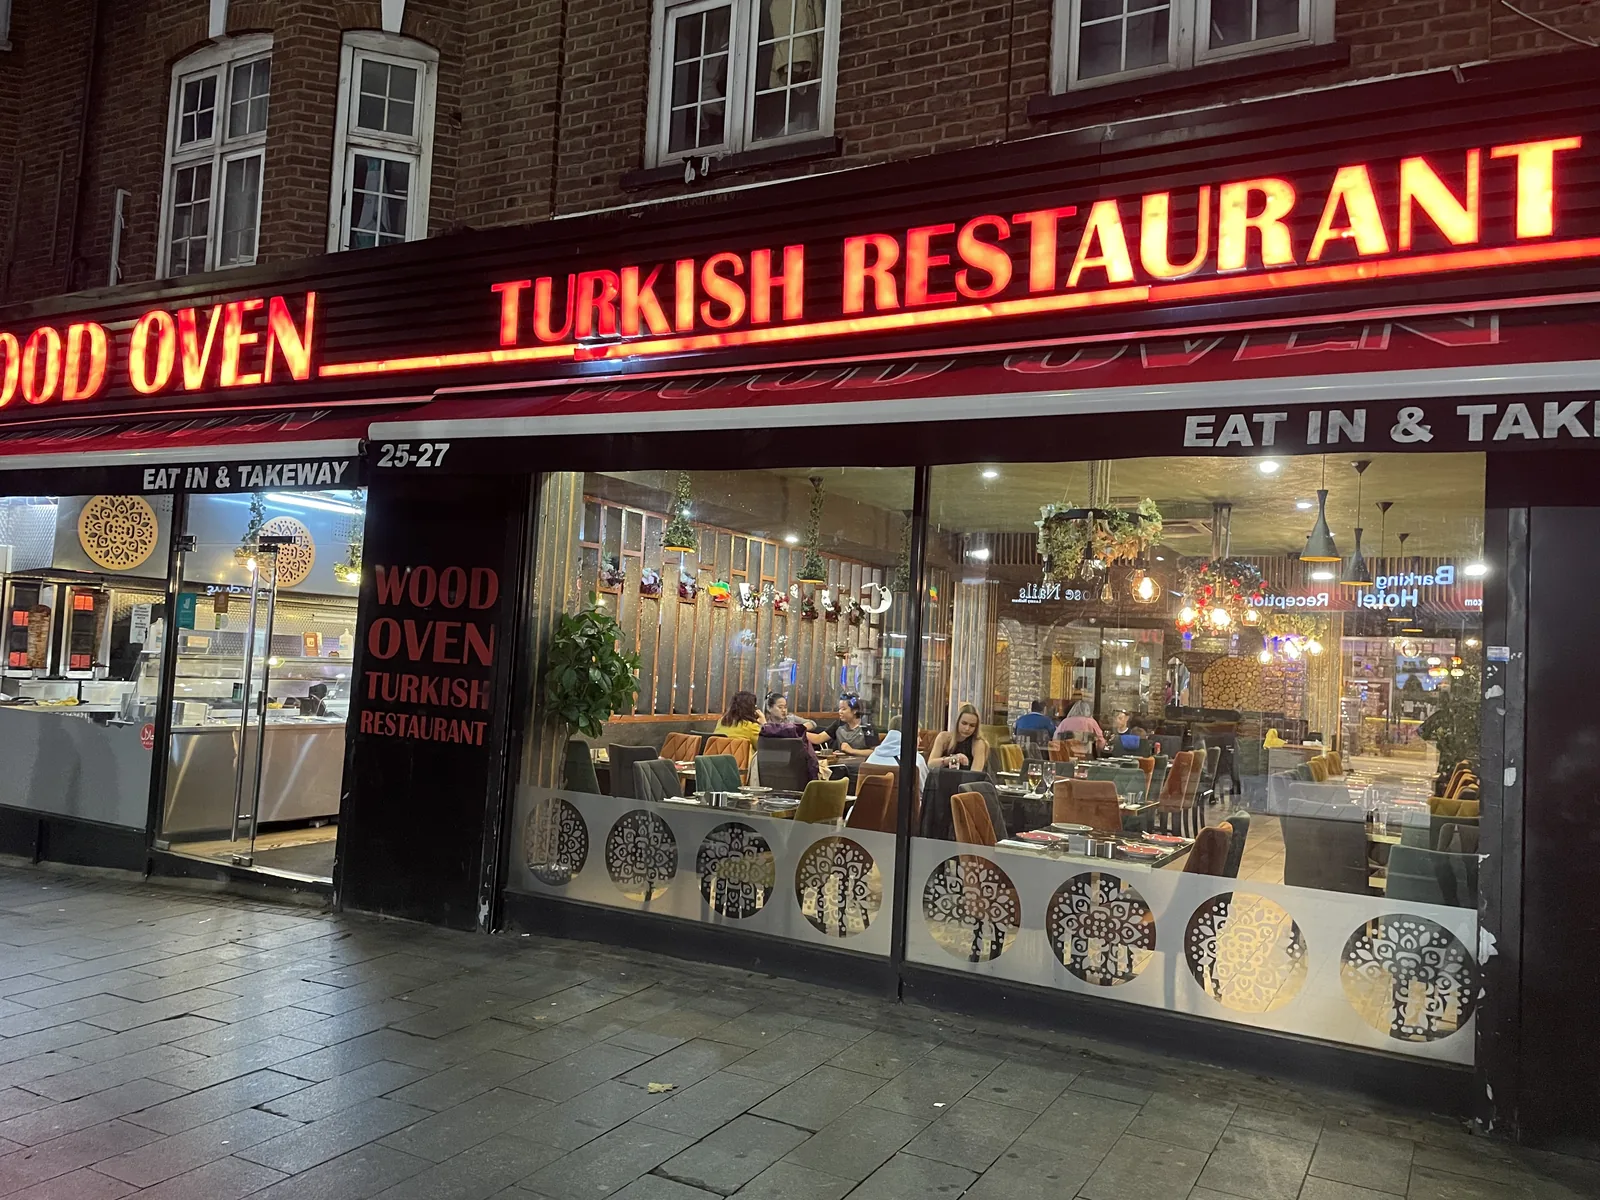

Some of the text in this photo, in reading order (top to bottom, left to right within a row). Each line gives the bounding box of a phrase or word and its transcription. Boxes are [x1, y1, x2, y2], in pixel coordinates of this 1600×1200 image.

[128, 291, 316, 394] OVEN
[490, 243, 805, 347] TURKISH
[842, 136, 1582, 314] RESTAURANT
[1183, 400, 1600, 448] EAT IN & TAK
[143, 460, 349, 491] EAT IN & TAKEWAY
[376, 442, 451, 469] 25-27
[374, 564, 499, 610] WOOD
[367, 617, 495, 667] OVEN
[365, 671, 491, 710] TURKISH
[360, 710, 488, 746] RESTAURANT
